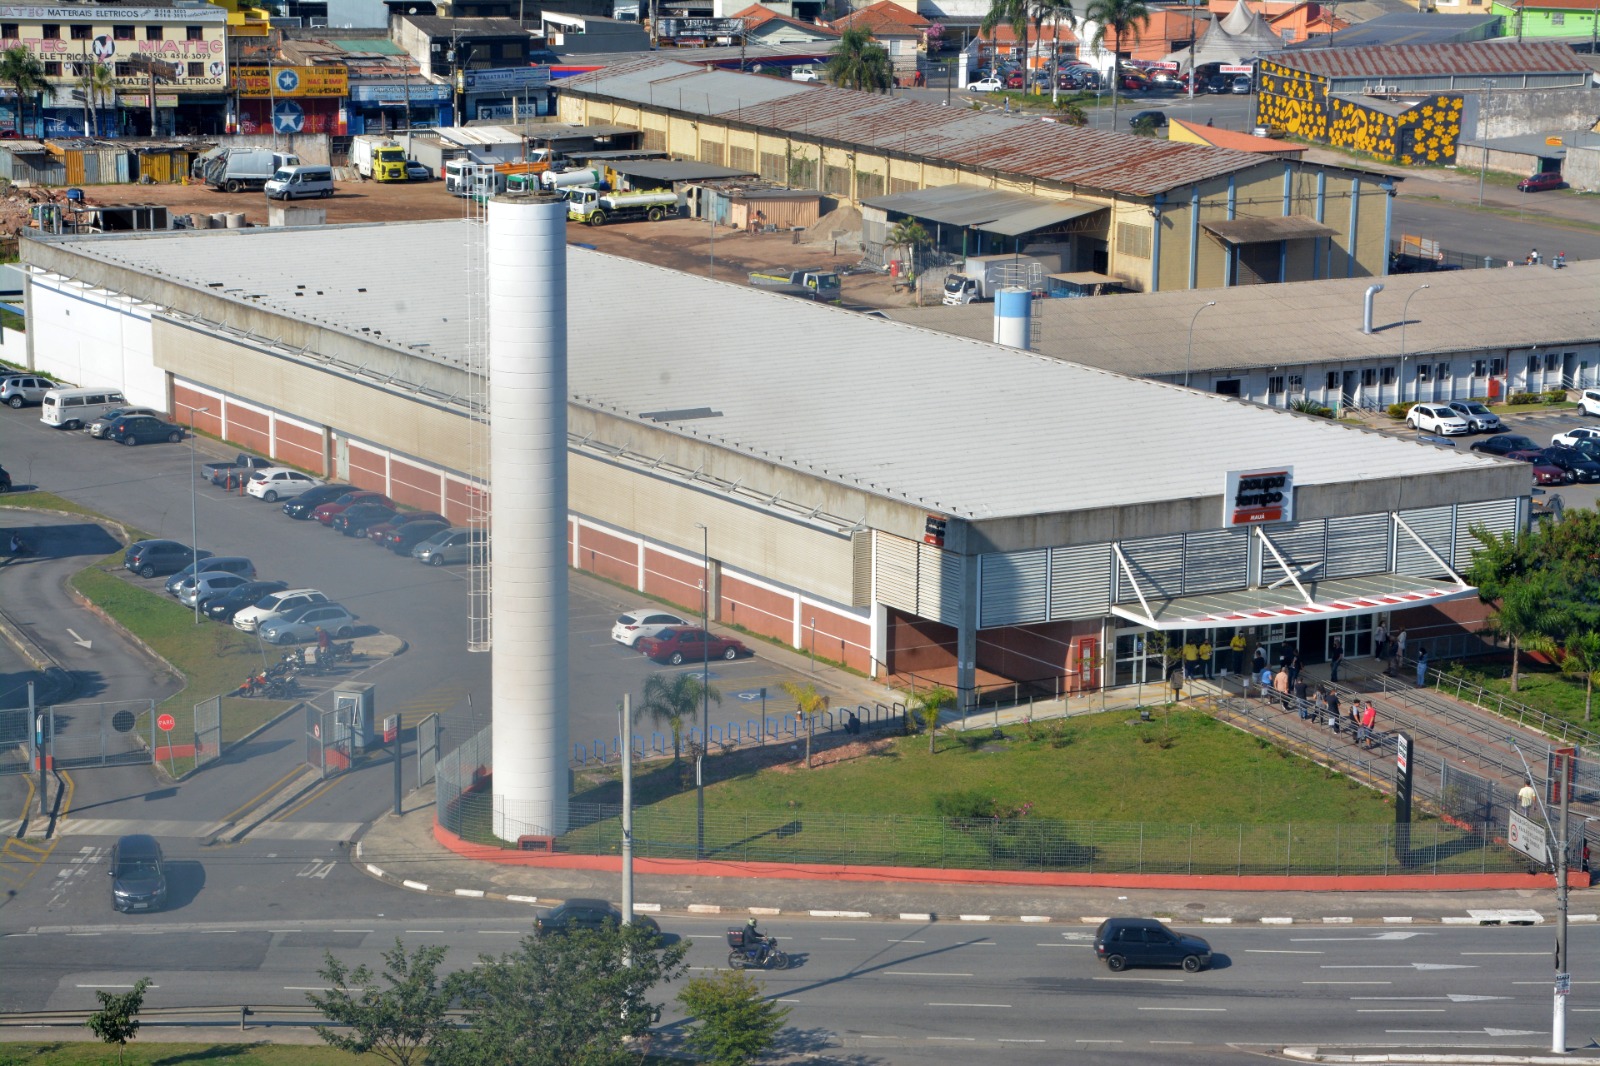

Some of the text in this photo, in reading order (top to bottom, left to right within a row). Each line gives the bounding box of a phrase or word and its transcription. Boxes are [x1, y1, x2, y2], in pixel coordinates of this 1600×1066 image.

[47, 9, 92, 17] MATERIAIS
[96, 10, 139, 18] ELETRICOS
[0, 38, 68, 52] IATEC
[139, 39, 223, 53] MIATEC
[40, 53, 94, 61] ELETRICOS
